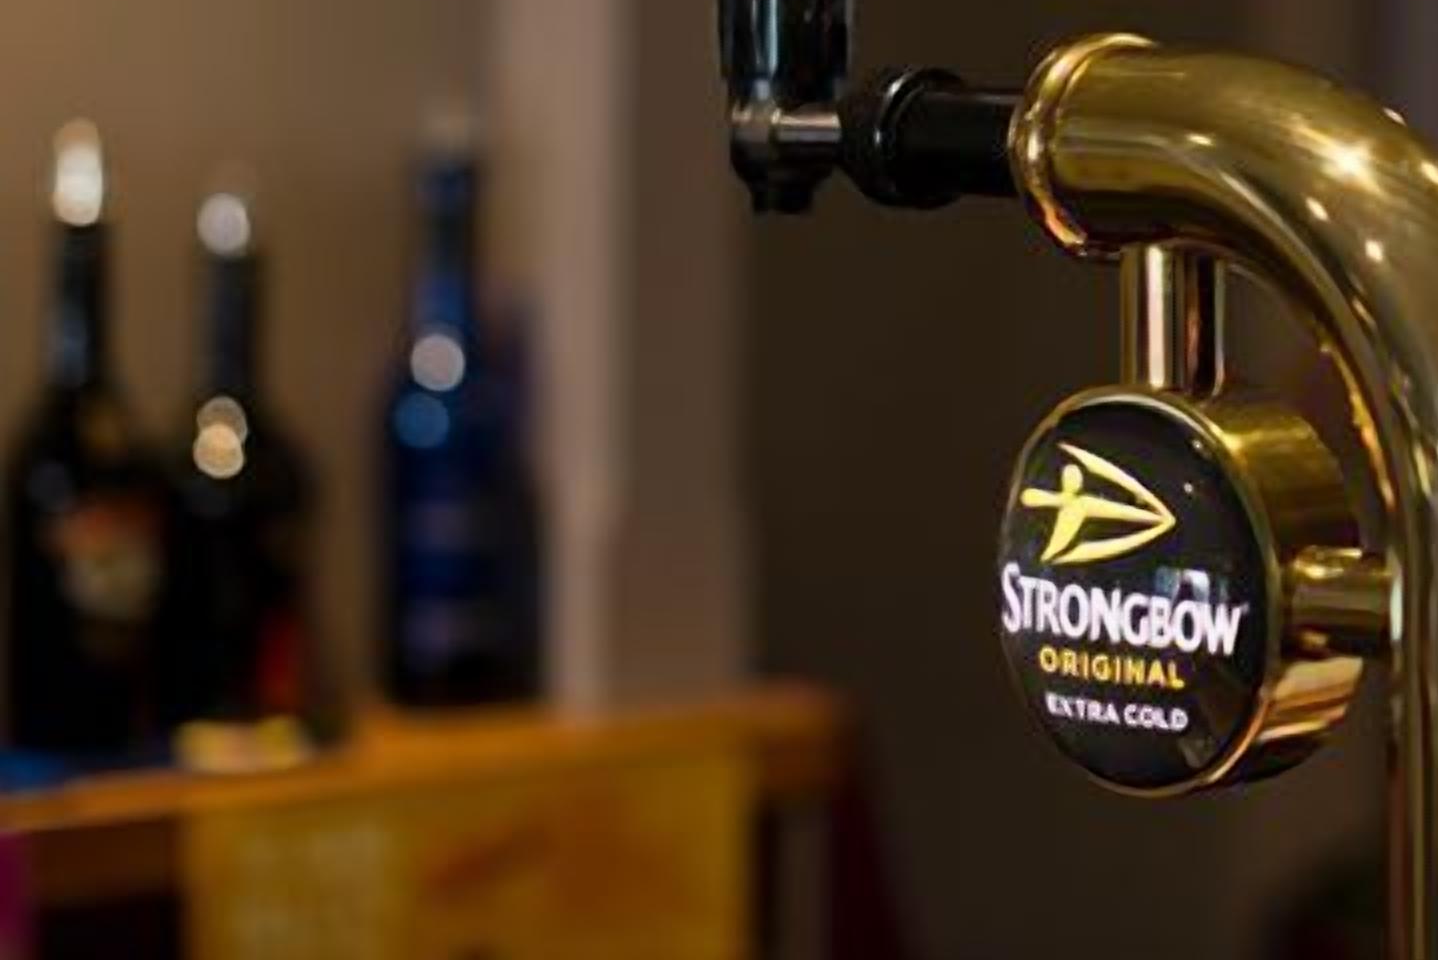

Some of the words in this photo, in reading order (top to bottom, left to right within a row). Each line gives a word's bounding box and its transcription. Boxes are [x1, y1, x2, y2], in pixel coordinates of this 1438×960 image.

[1002, 562, 1241, 655] STRONGBOW
[1038, 647, 1185, 689] ORIGINAL
[1045, 691, 1120, 724] EXTRA
[1123, 703, 1189, 732] COLD
